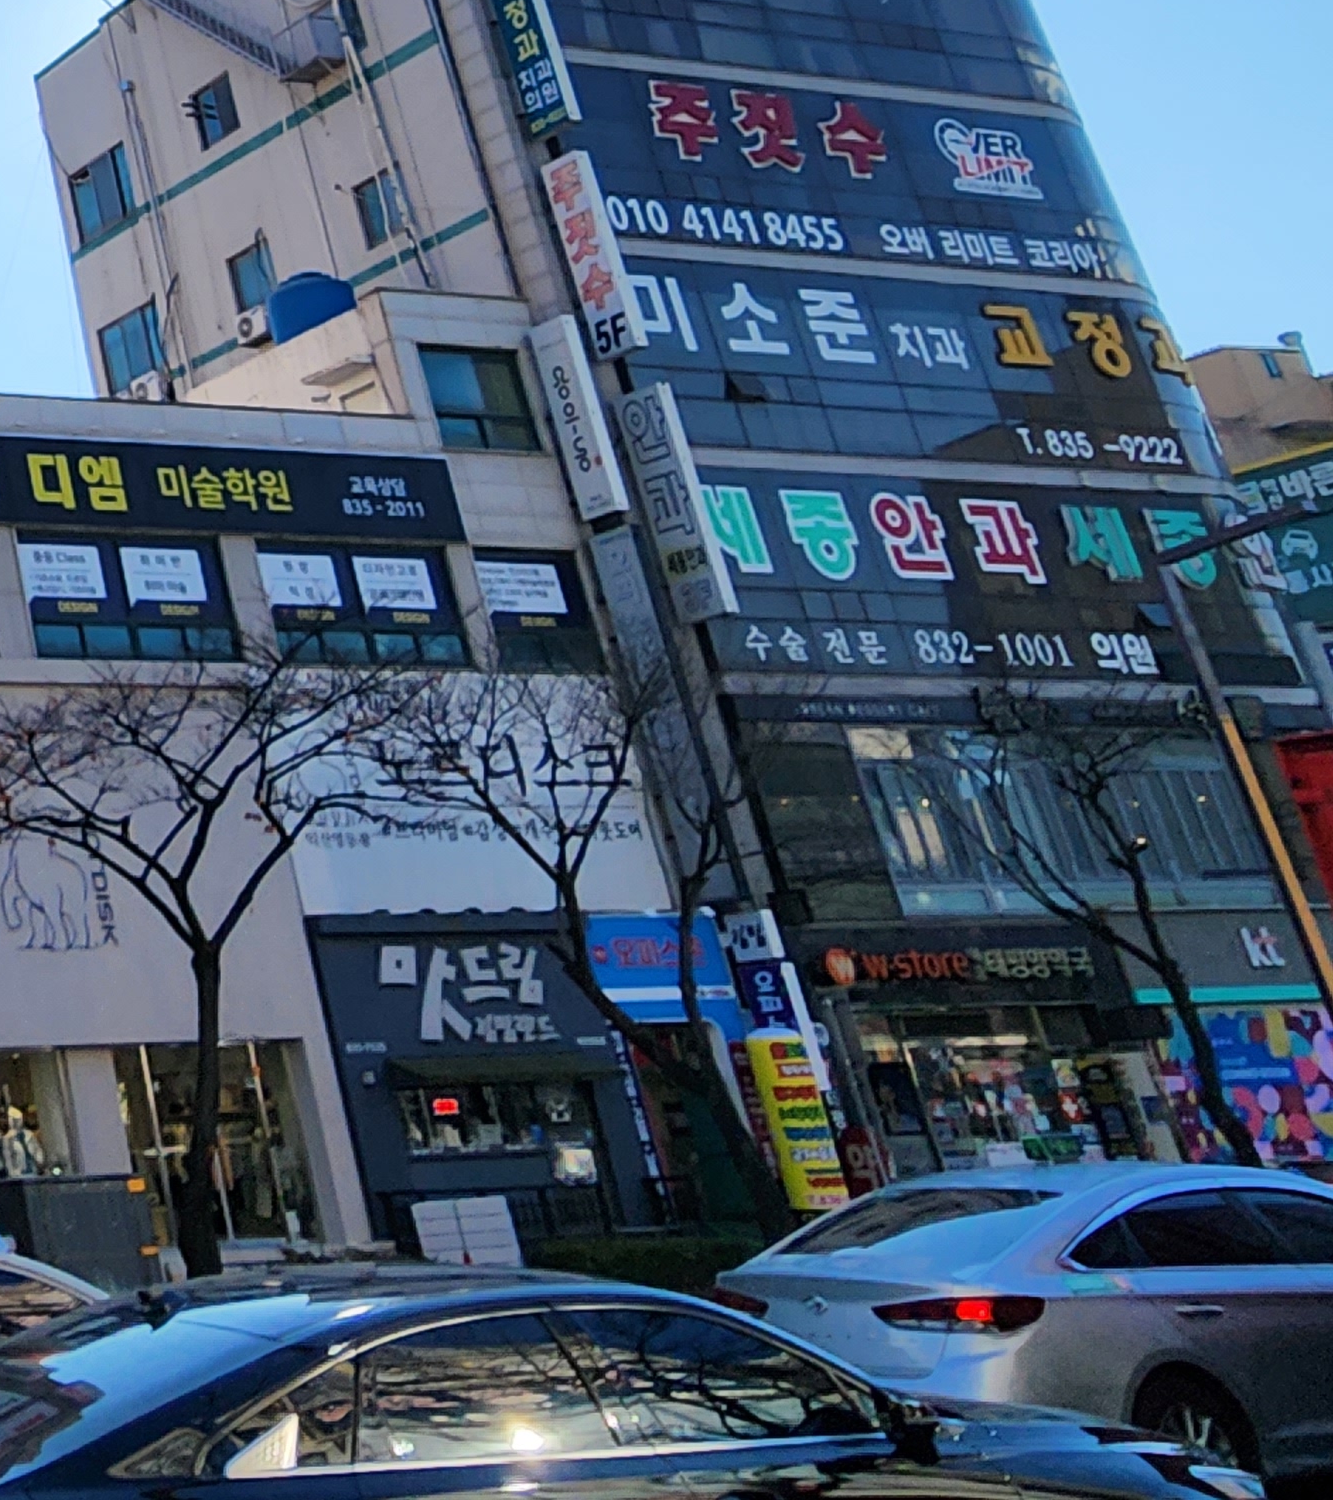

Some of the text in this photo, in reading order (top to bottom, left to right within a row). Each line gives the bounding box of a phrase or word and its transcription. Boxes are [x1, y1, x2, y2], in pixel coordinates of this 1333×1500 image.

[648, 80, 887, 179] 주짓수
[606, 196, 1102, 275] 010 4141 8455 오버 리미트 코리아
[595, 312, 627, 355] 5F
[633, 274, 878, 365] 미소준
[889, 321, 969, 370] 치과
[27, 453, 293, 513] 디엠 미술학원
[744, 625, 1159, 675] 수술 전문 832-1001 의원
[1240, 927, 1284, 966] kt
